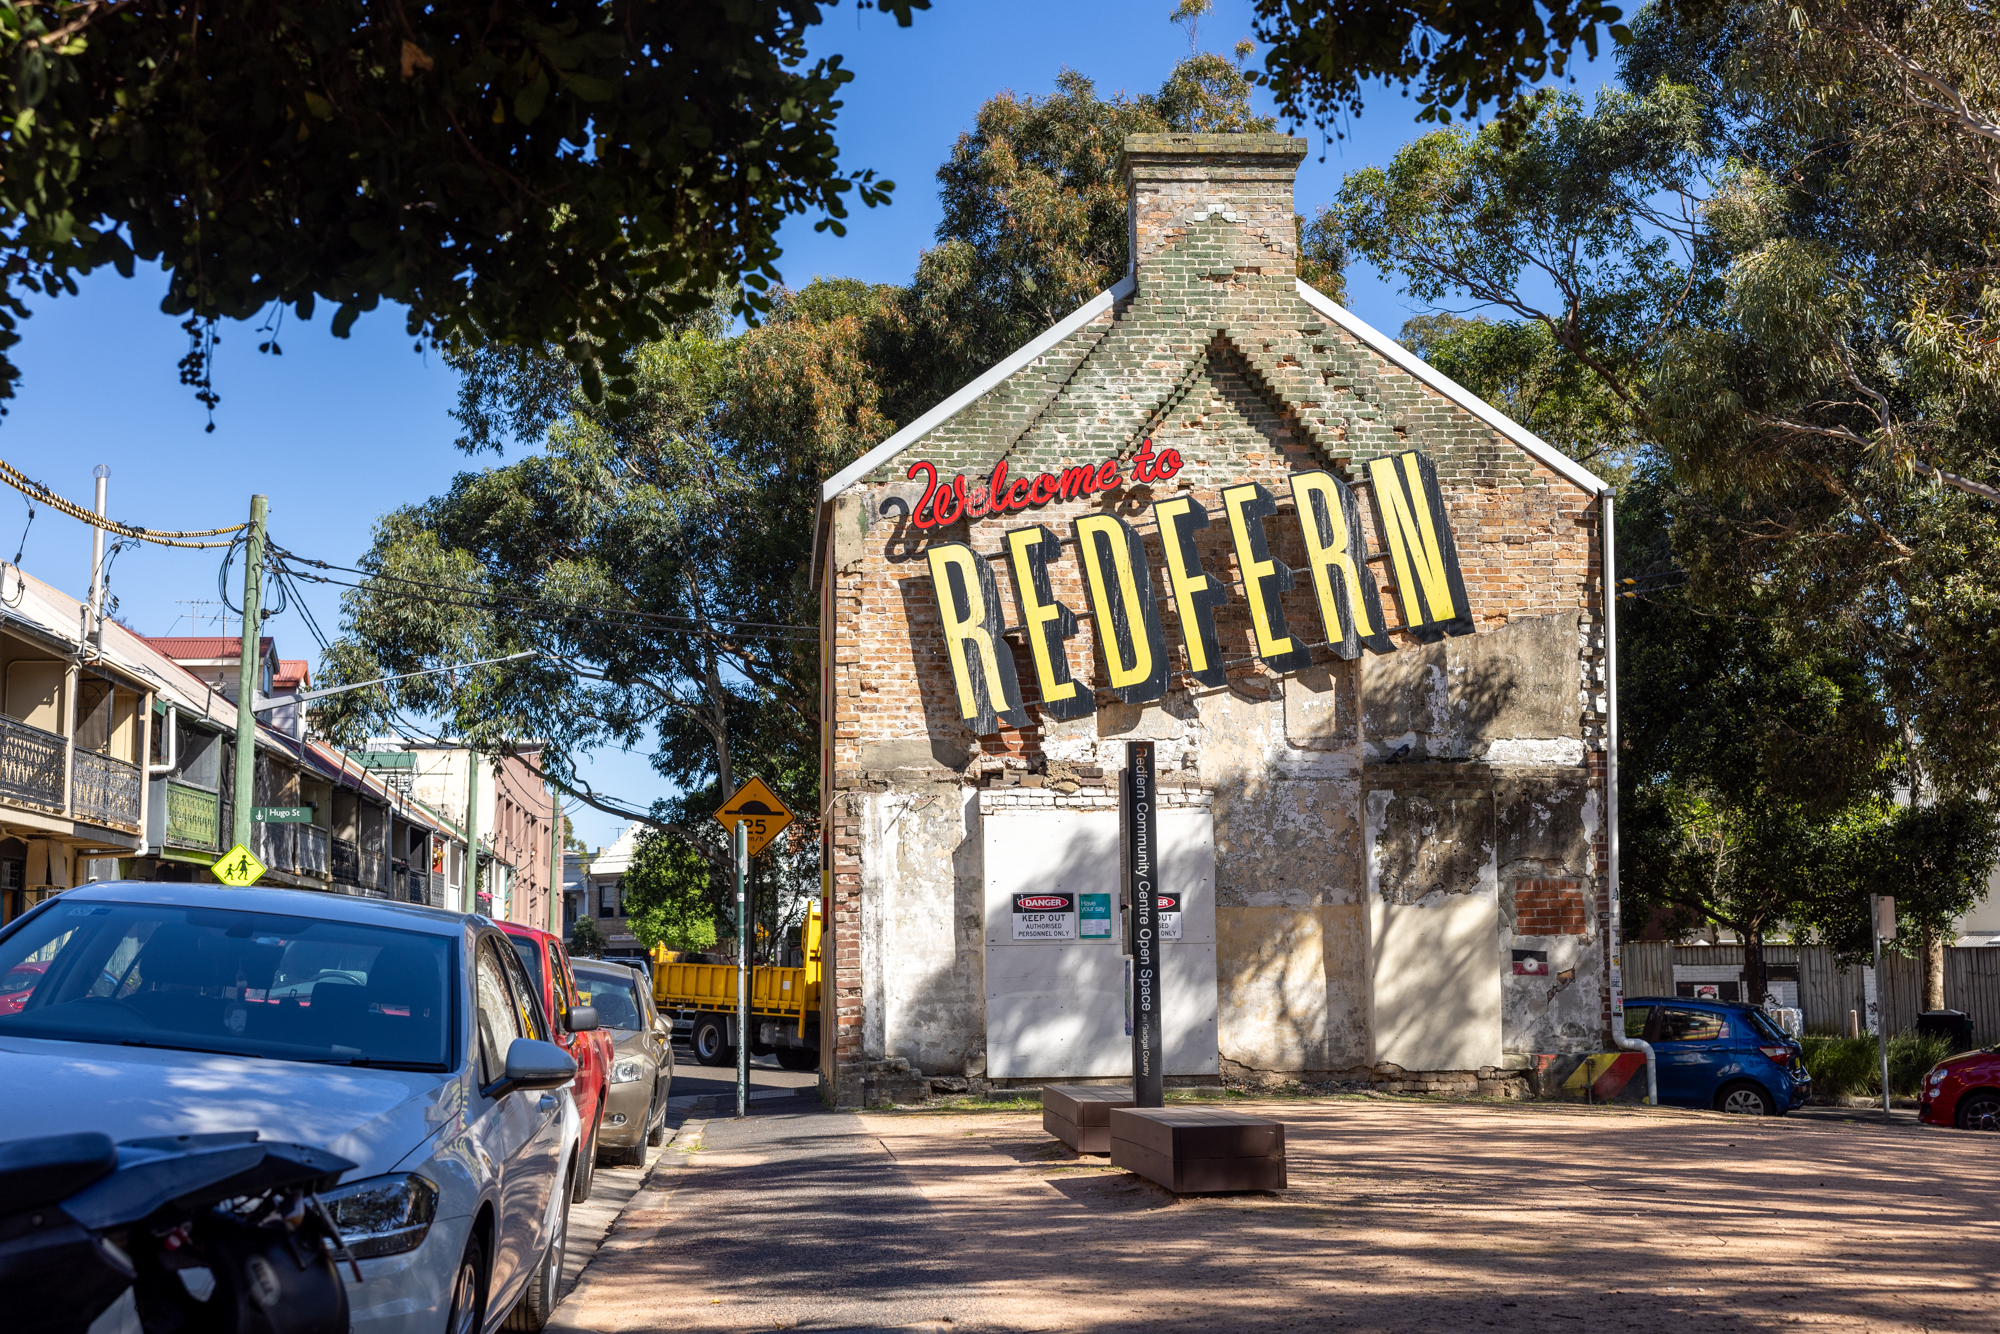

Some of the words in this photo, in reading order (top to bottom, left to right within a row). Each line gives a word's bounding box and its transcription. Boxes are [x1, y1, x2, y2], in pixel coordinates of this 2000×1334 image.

[906, 458, 1123, 530] Welcome
[1130, 439, 1184, 483] to
[926, 450, 1468, 730] REDFERN
[1136, 748, 1148, 799] Redfern
[269, 808, 290, 818] Hugo
[292, 808, 300, 817] St
[743, 819, 766, 835] 25
[1135, 802, 1150, 877] Community
[1022, 914, 1045, 922] KEEP
[1048, 914, 1066, 922] OUT
[1025, 899, 1062, 907] DANGER
[1138, 881, 1151, 925] Centre
[1137, 928, 1152, 965] Open
[1138, 969, 1153, 1011] Space
[1141, 1024, 1149, 1050] Gadigal
[1142, 1051, 1150, 1077] Country
